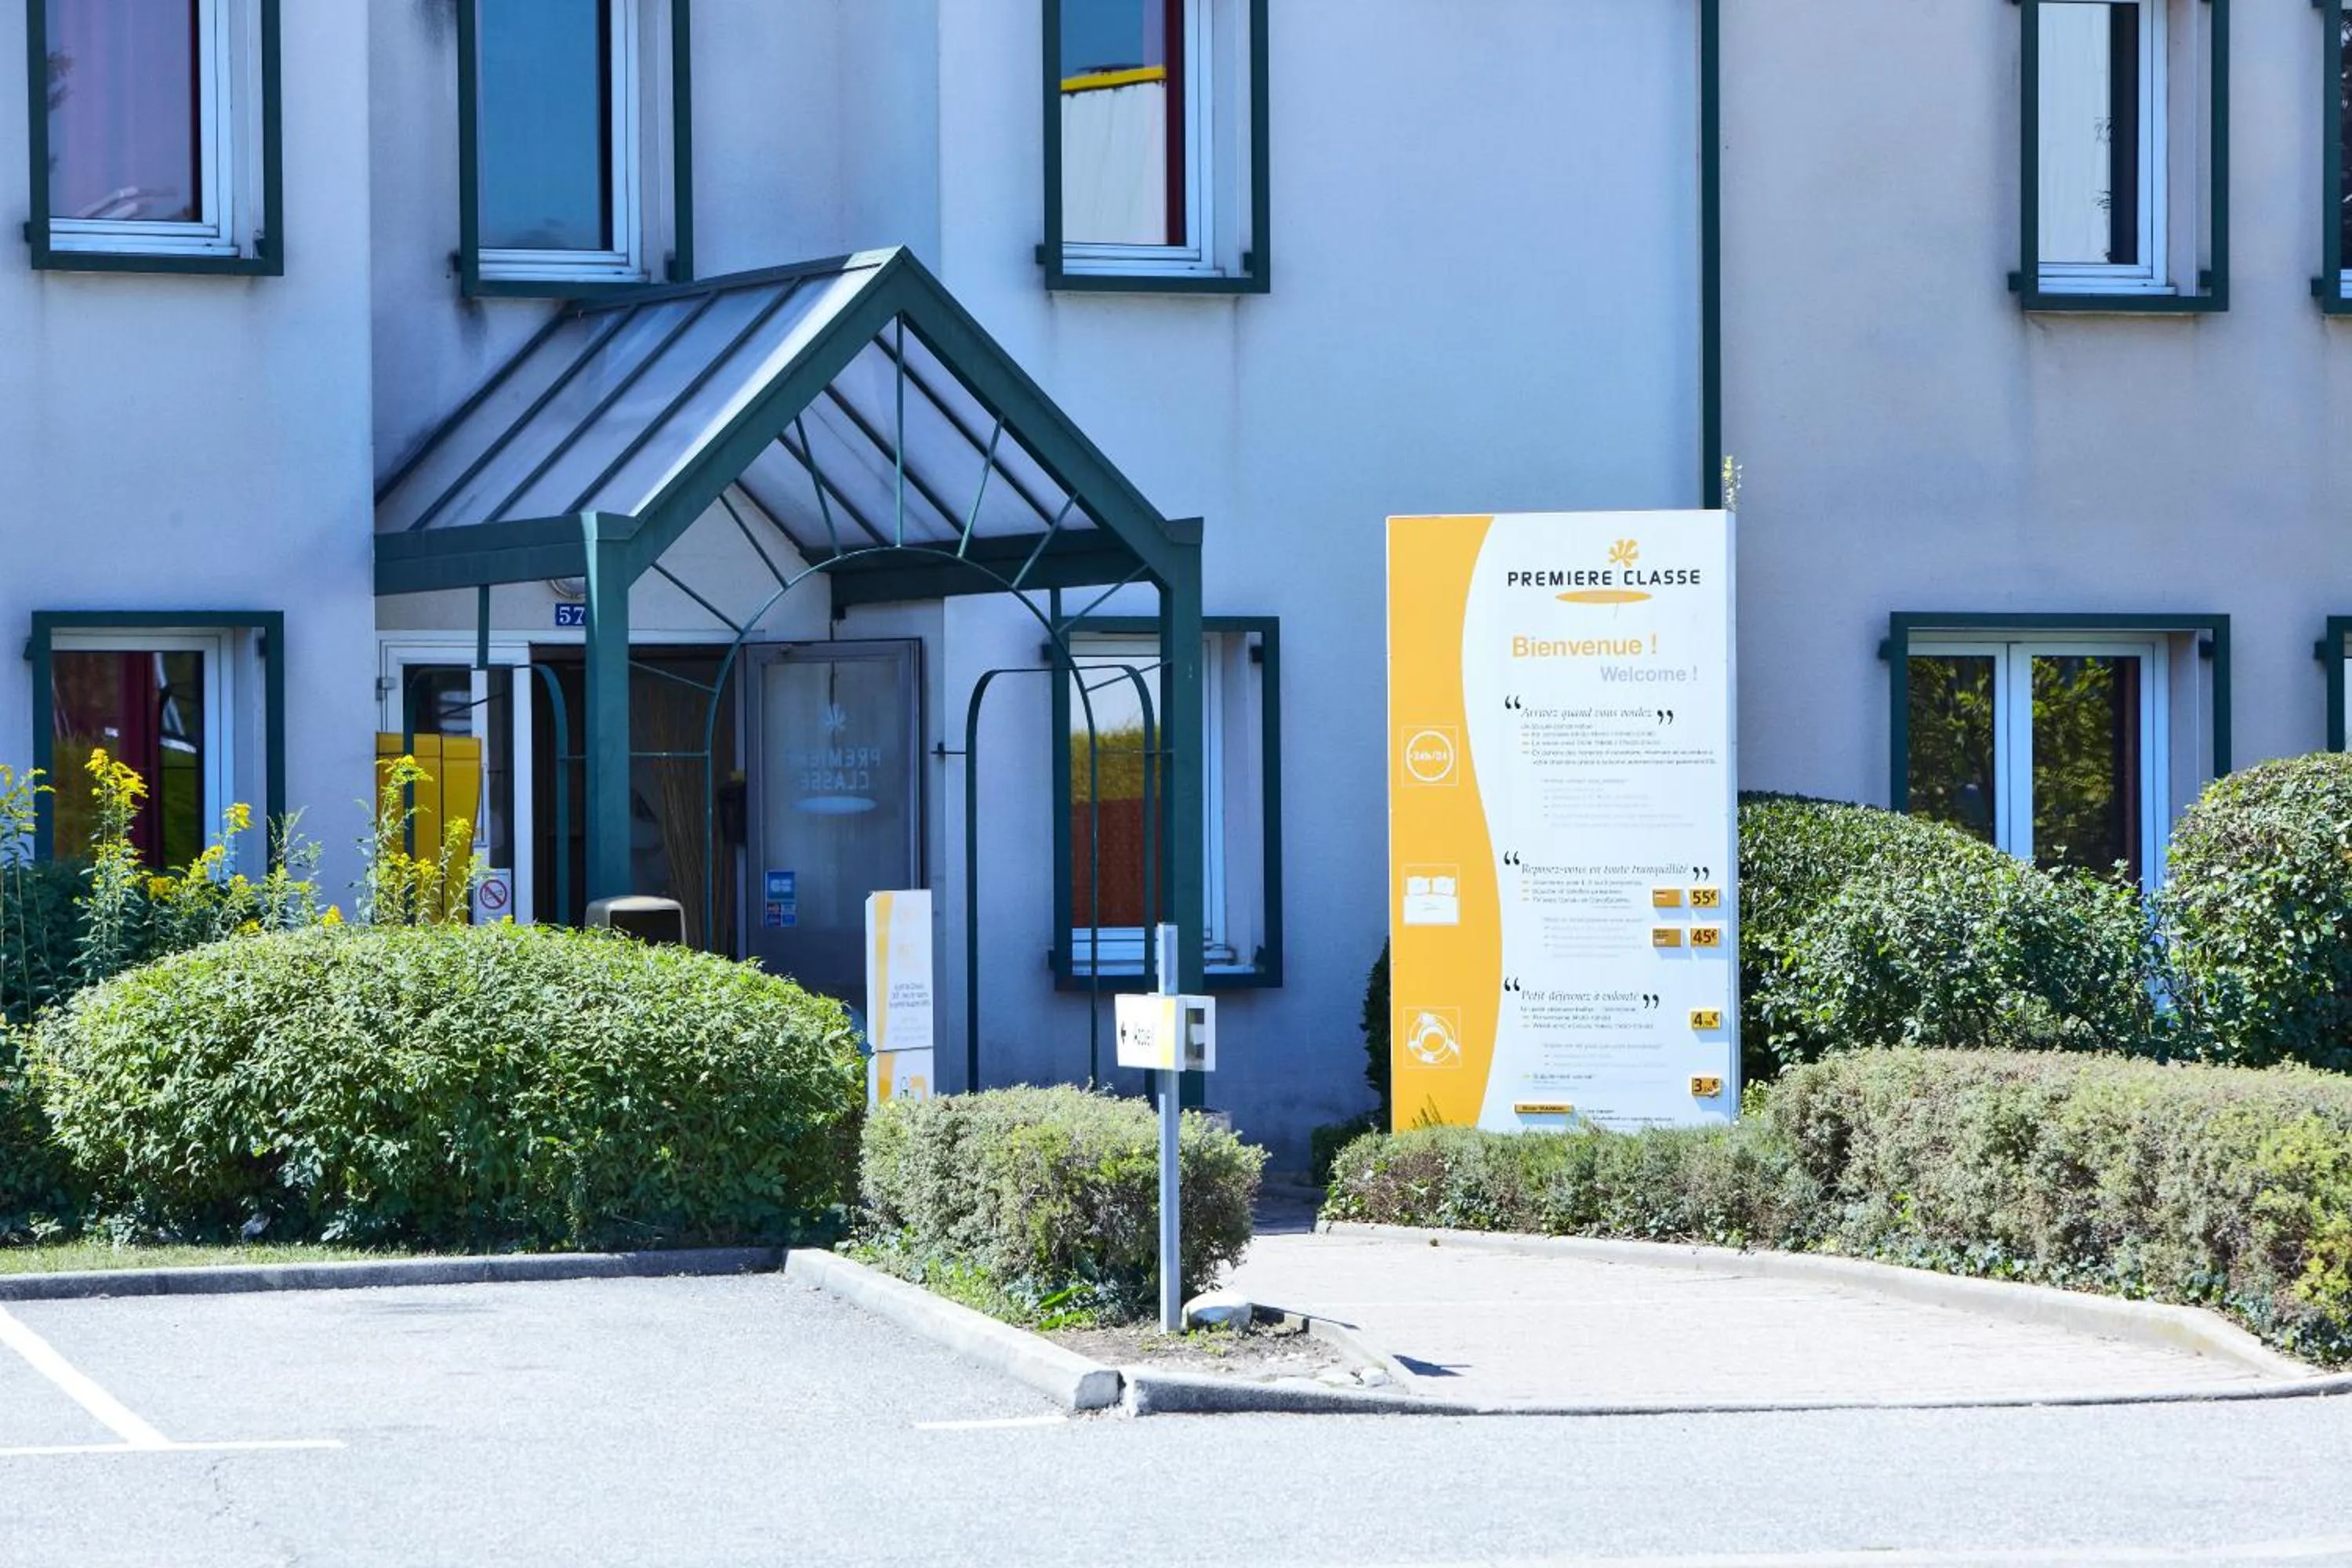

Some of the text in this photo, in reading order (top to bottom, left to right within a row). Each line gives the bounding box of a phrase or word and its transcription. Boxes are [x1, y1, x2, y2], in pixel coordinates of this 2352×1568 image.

[1507, 569, 1700, 586] PREMIERE CLASSE
[559, 606, 586, 625] 57
[1511, 635, 1642, 658] Bienvenue
[1599, 666, 1687, 682] Welcome
[1693, 890, 1717, 905] 55€
[1693, 929, 1717, 943] 45€
